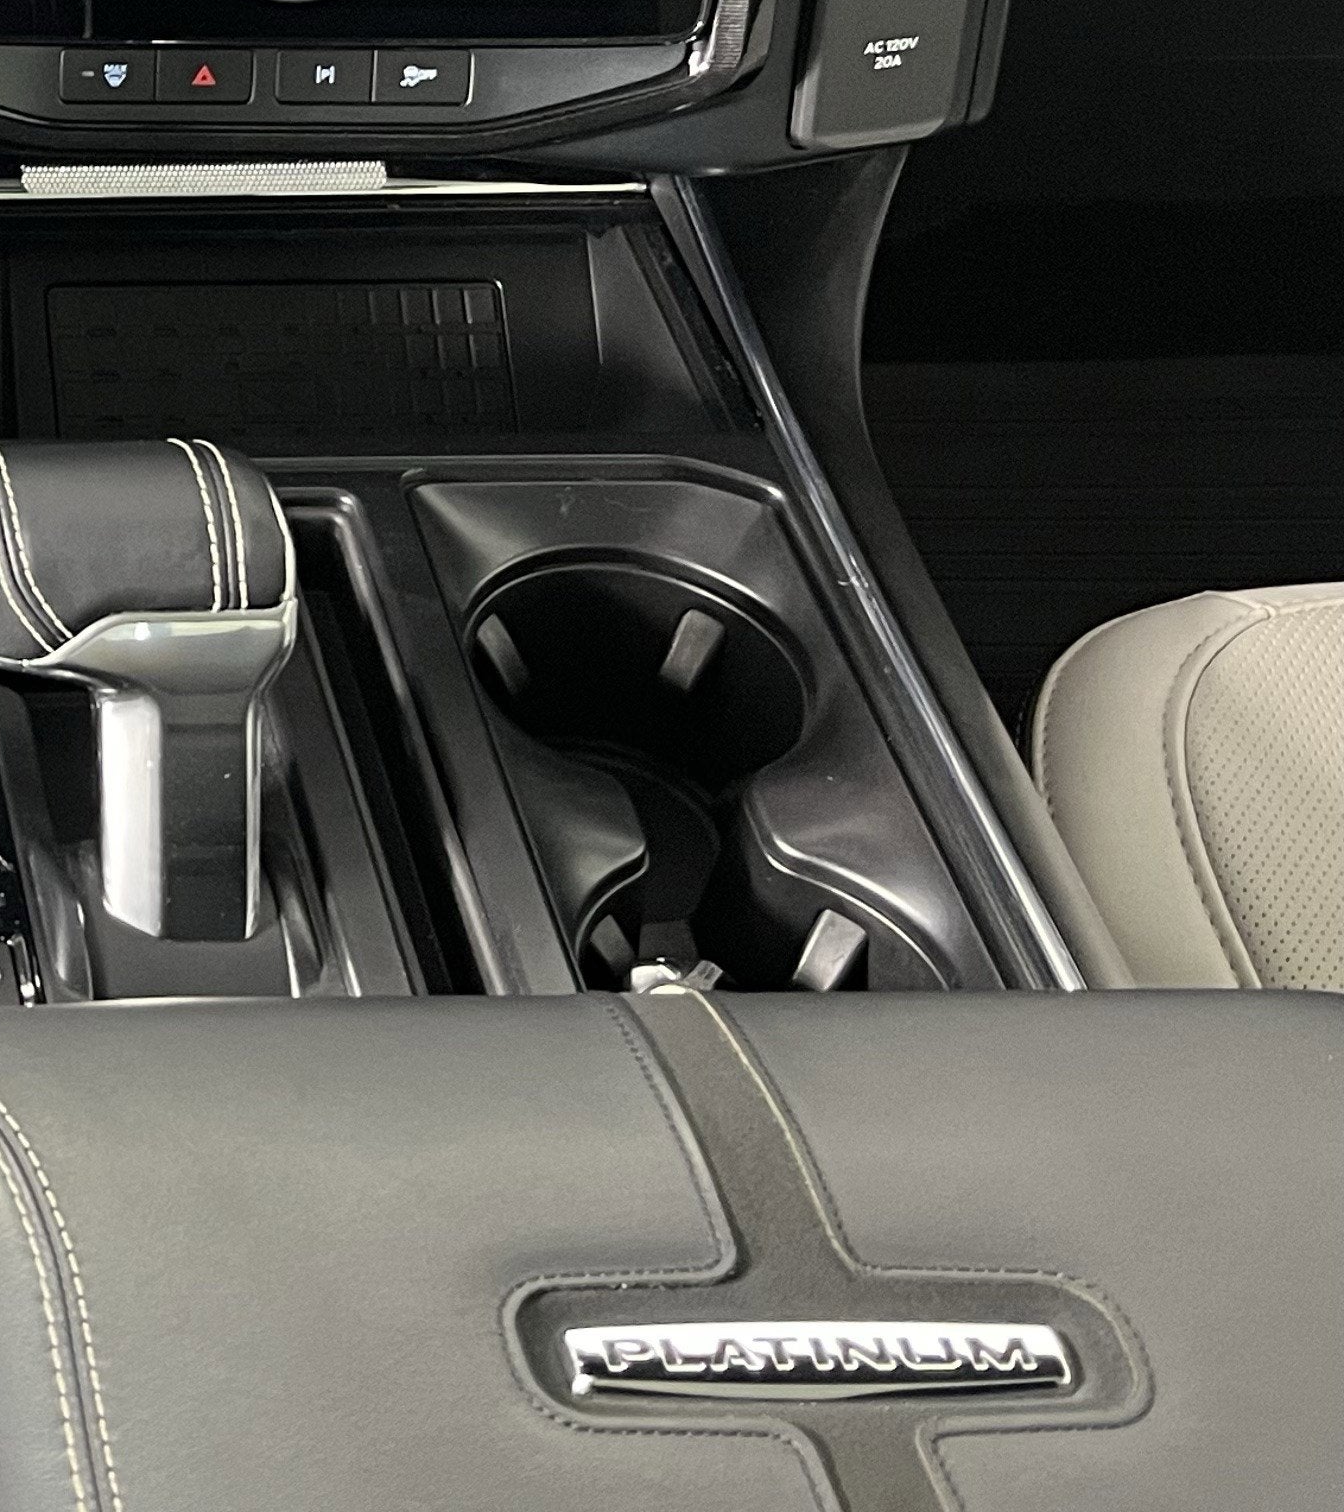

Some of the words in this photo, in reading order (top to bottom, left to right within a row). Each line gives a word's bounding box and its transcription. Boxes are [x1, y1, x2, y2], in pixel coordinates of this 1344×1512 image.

[864, 42, 885, 54] AC
[886, 36, 920, 51] 120V
[874, 55, 902, 69] 20A
[602, 1337, 1038, 1372] PLATINUM
